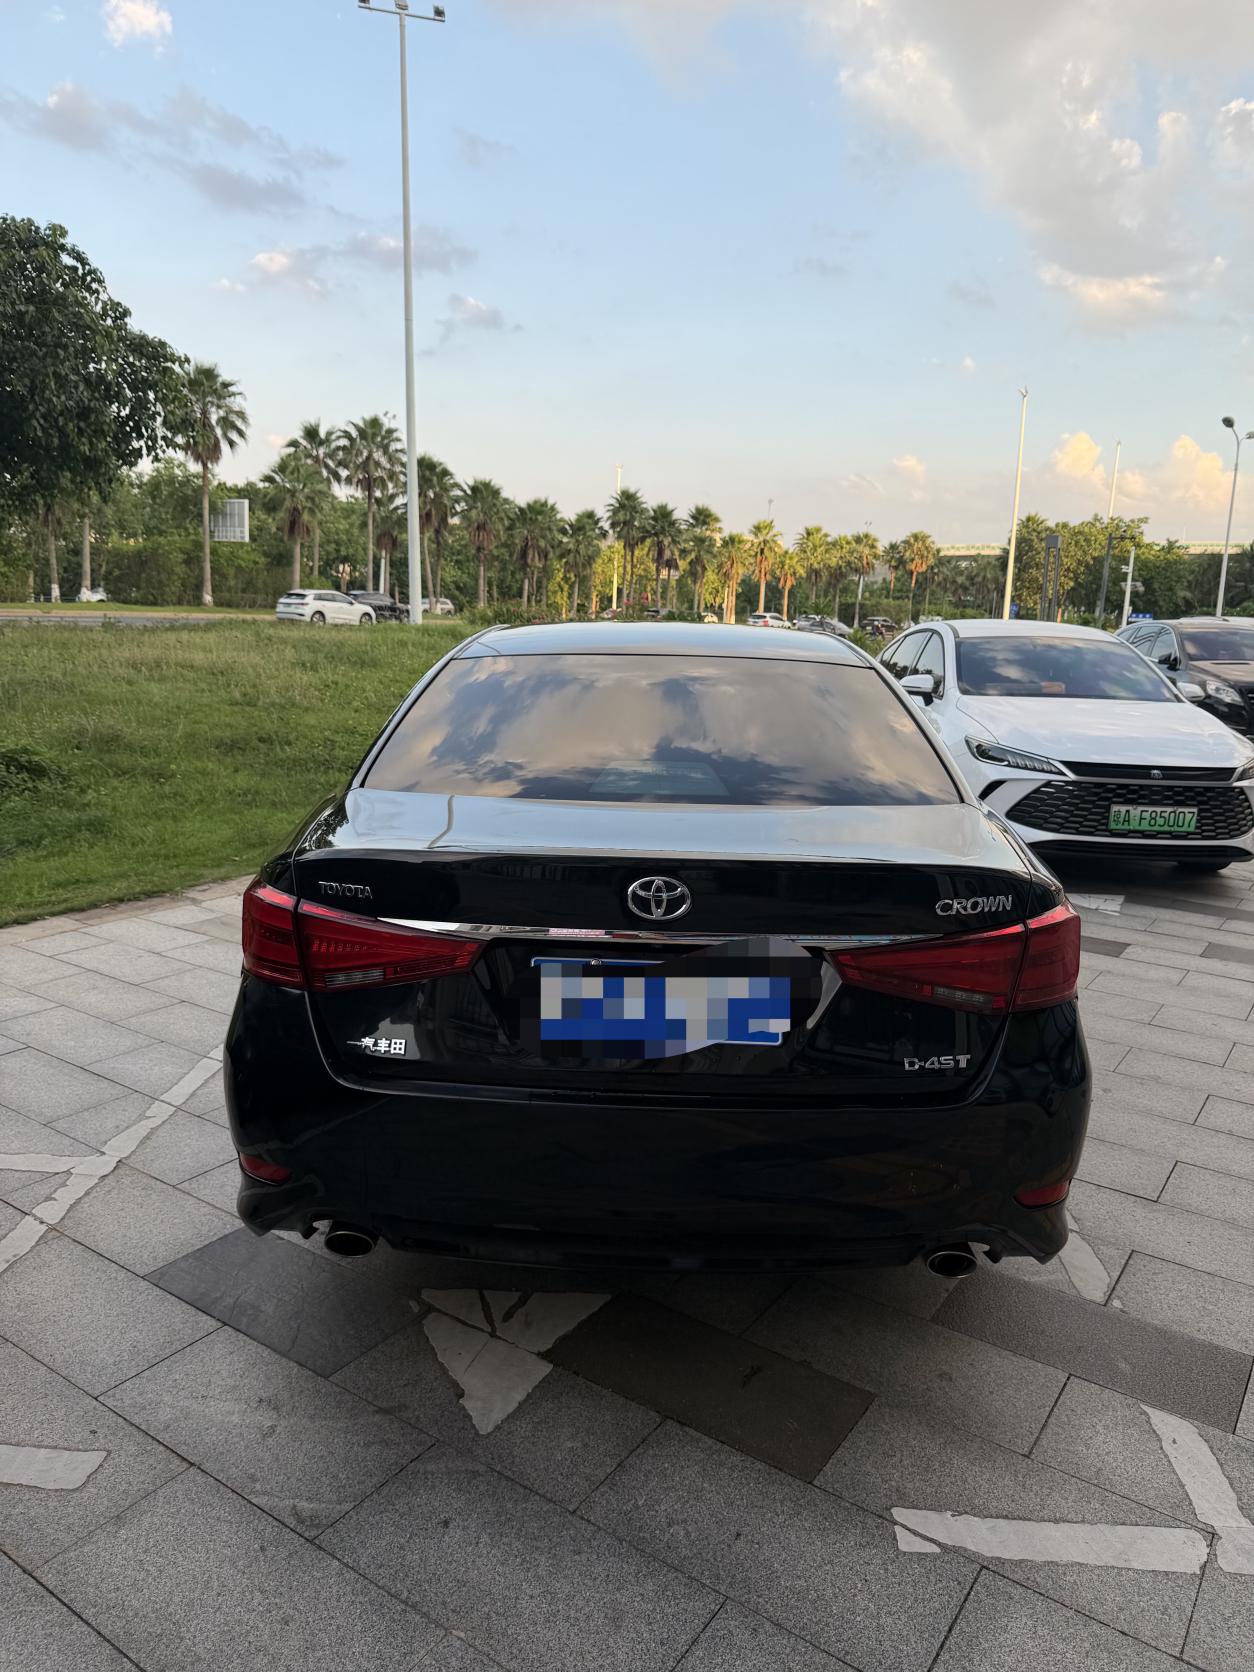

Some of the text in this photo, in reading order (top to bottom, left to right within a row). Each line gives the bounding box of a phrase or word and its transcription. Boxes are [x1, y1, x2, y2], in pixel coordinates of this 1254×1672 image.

[318, 881, 373, 900] TOYOTA
[935, 894, 1013, 916] CROWN
[346, 1036, 406, 1055] 一汽丰田
